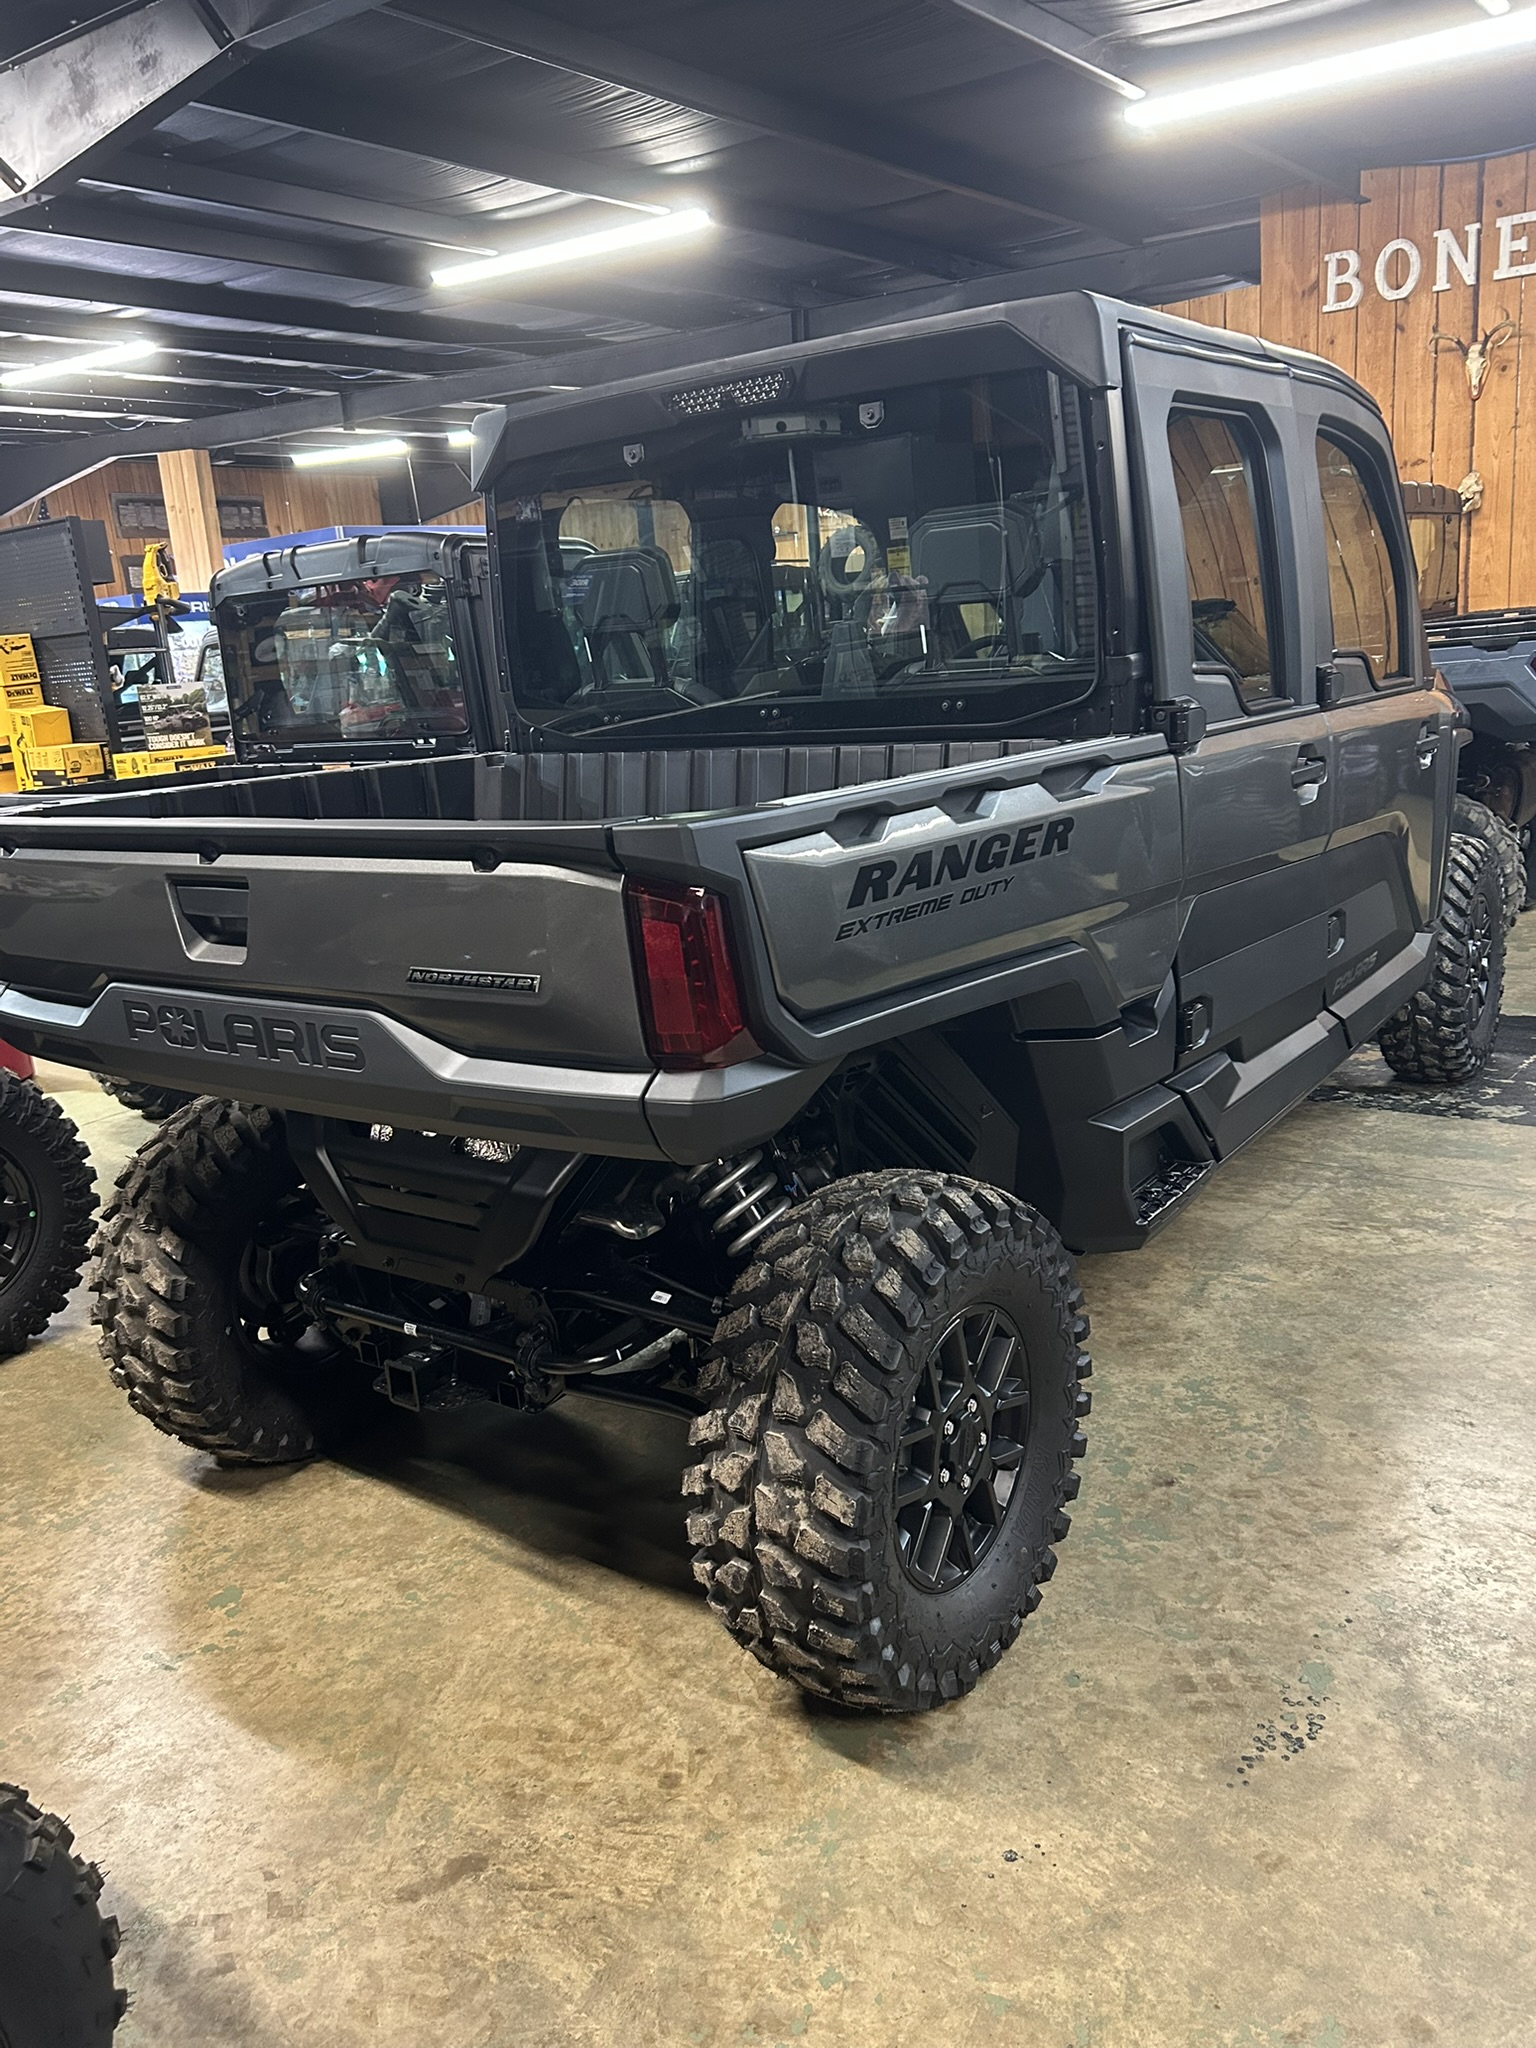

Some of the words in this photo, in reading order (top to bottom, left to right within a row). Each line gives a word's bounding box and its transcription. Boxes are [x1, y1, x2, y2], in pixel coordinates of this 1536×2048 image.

[1322, 211, 1536, 313] BONE
[147, 735, 168, 743] TOUGH
[169, 732, 195, 741] DOESN'T
[148, 741, 180, 750] CONSIDER
[187, 738, 206, 747] WORK
[847, 817, 1075, 909] RANGER
[834, 893, 954, 942] EXTREME
[960, 876, 1015, 905] DUTY
[411, 971, 534, 991] NORTHSTAR
[122, 1000, 367, 1073] POLARIS
